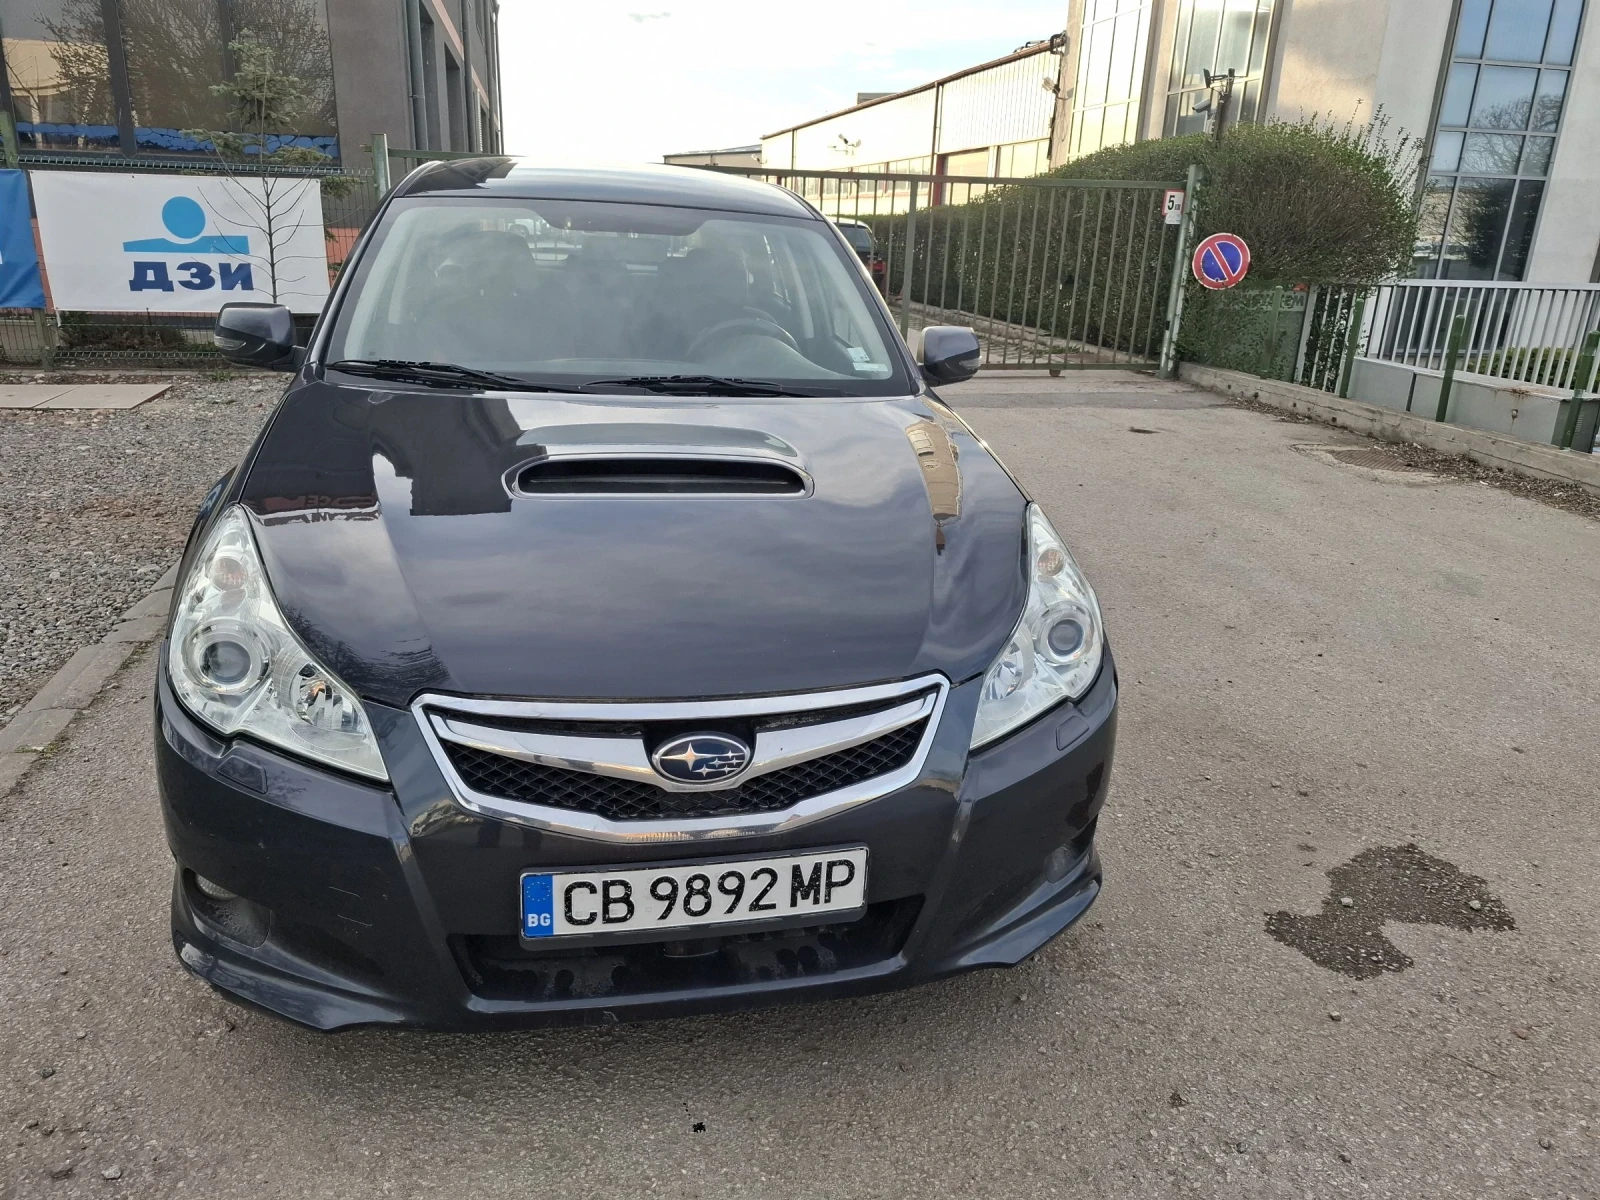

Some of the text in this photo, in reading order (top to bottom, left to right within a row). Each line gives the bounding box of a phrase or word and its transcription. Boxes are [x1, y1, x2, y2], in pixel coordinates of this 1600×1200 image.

[1167, 194, 1175, 210] 5
[128, 261, 254, 292] ДЗИ
[563, 859, 856, 926] CB 9892 MP
[528, 913, 551, 927] BG
